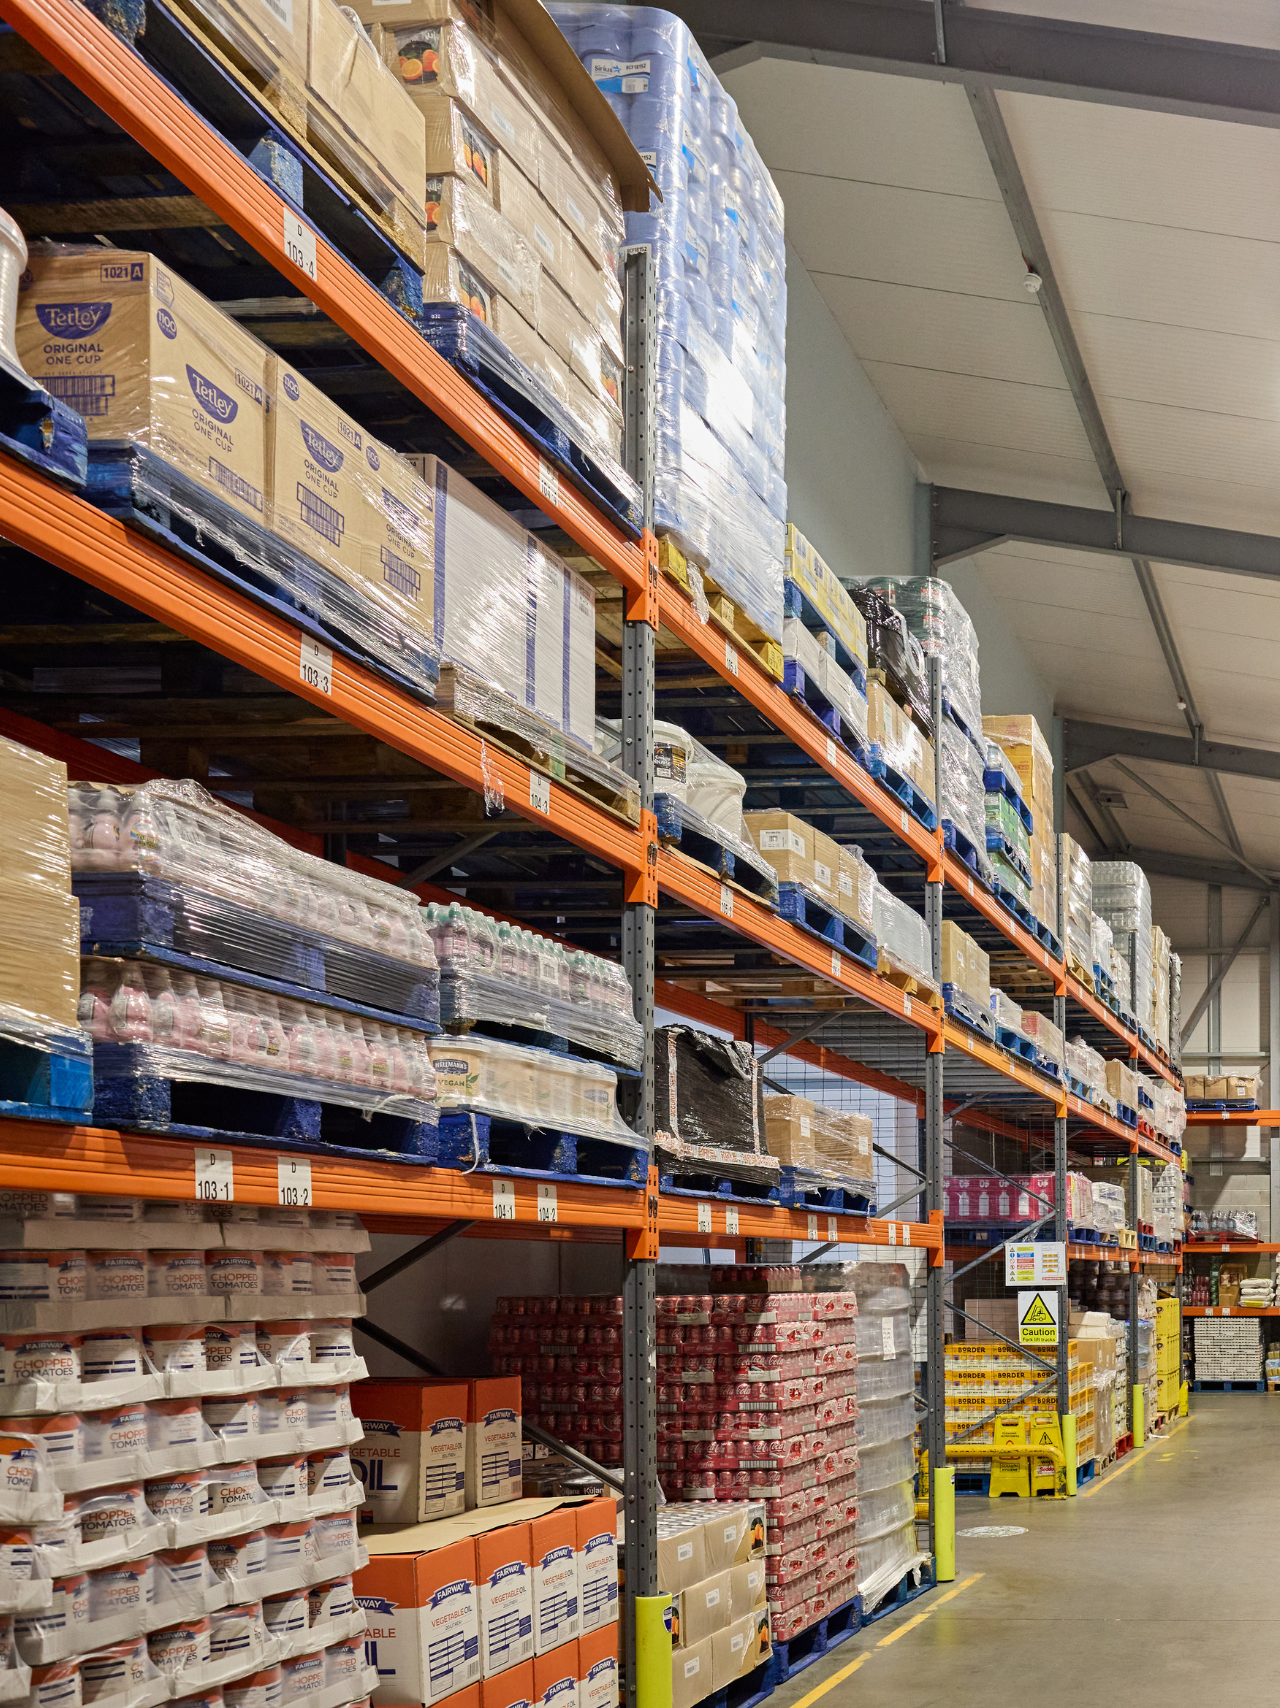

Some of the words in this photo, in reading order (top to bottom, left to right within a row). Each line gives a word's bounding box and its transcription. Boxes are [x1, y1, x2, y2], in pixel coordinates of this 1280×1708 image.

[594, 64, 613, 73] Sirius
[103, 266, 130, 280] 1021
[45, 307, 103, 331] Tetley
[44, 343, 104, 354] ORIGINAL
[45, 355, 72, 366] ONE
[78, 354, 102, 365] CUP
[193, 372, 234, 417] Tetley
[191, 408, 235, 447] ORIGINAL
[193, 421, 214, 441] ONE
[214, 436, 233, 454] CUP
[305, 428, 340, 469] Tetley
[303, 459, 340, 493] ORIGINAL
[305, 471, 321, 489] ONE
[322, 483, 338, 500] CUP
[314, 645, 319, 656] D
[437, 1079, 465, 1087] VEGAN
[211, 1154, 216, 1165] D
[292, 1162, 296, 1173] D
[105, 1259, 139, 1268] FAIRWAY
[220, 1258, 252, 1266] FAIRWAY
[97, 1274, 145, 1284] CHOPPED
[210, 1272, 258, 1282] CHOPPED
[95, 1283, 145, 1293] TOMATOES
[210, 1281, 258, 1290] TOMATOES
[1022, 1328, 1055, 1336] Caution
[25, 1342, 65, 1351] FAIRWAY
[13, 1358, 74, 1370] CHOPPED
[15, 1367, 74, 1379] TOMATOES
[489, 1411, 512, 1421] FAIRWAY
[436, 1419, 460, 1430] FAIRWAY
[485, 1433, 510, 1442] VEGETABLE
[430, 1442, 458, 1453] VEGETABLE
[80, 1516, 137, 1530] TOMATOES
[589, 1535, 609, 1548] FAIRWAY
[546, 1548, 569, 1563] FAIRWAY
[585, 1557, 609, 1570] VEGETABLE
[496, 1563, 521, 1580] FAIRWAY
[542, 1570, 567, 1586] VEGETABLE
[437, 1582, 465, 1601] FAIRWAY
[490, 1589, 520, 1605] VEGETABLE
[431, 1608, 464, 1627] VEGETABLE
[464, 1605, 473, 1614] OIL
[592, 1658, 611, 1674] FAIRWAY
[548, 1680, 570, 1696] FAIRWAY
[588, 1682, 611, 1698] VEGETABLE
